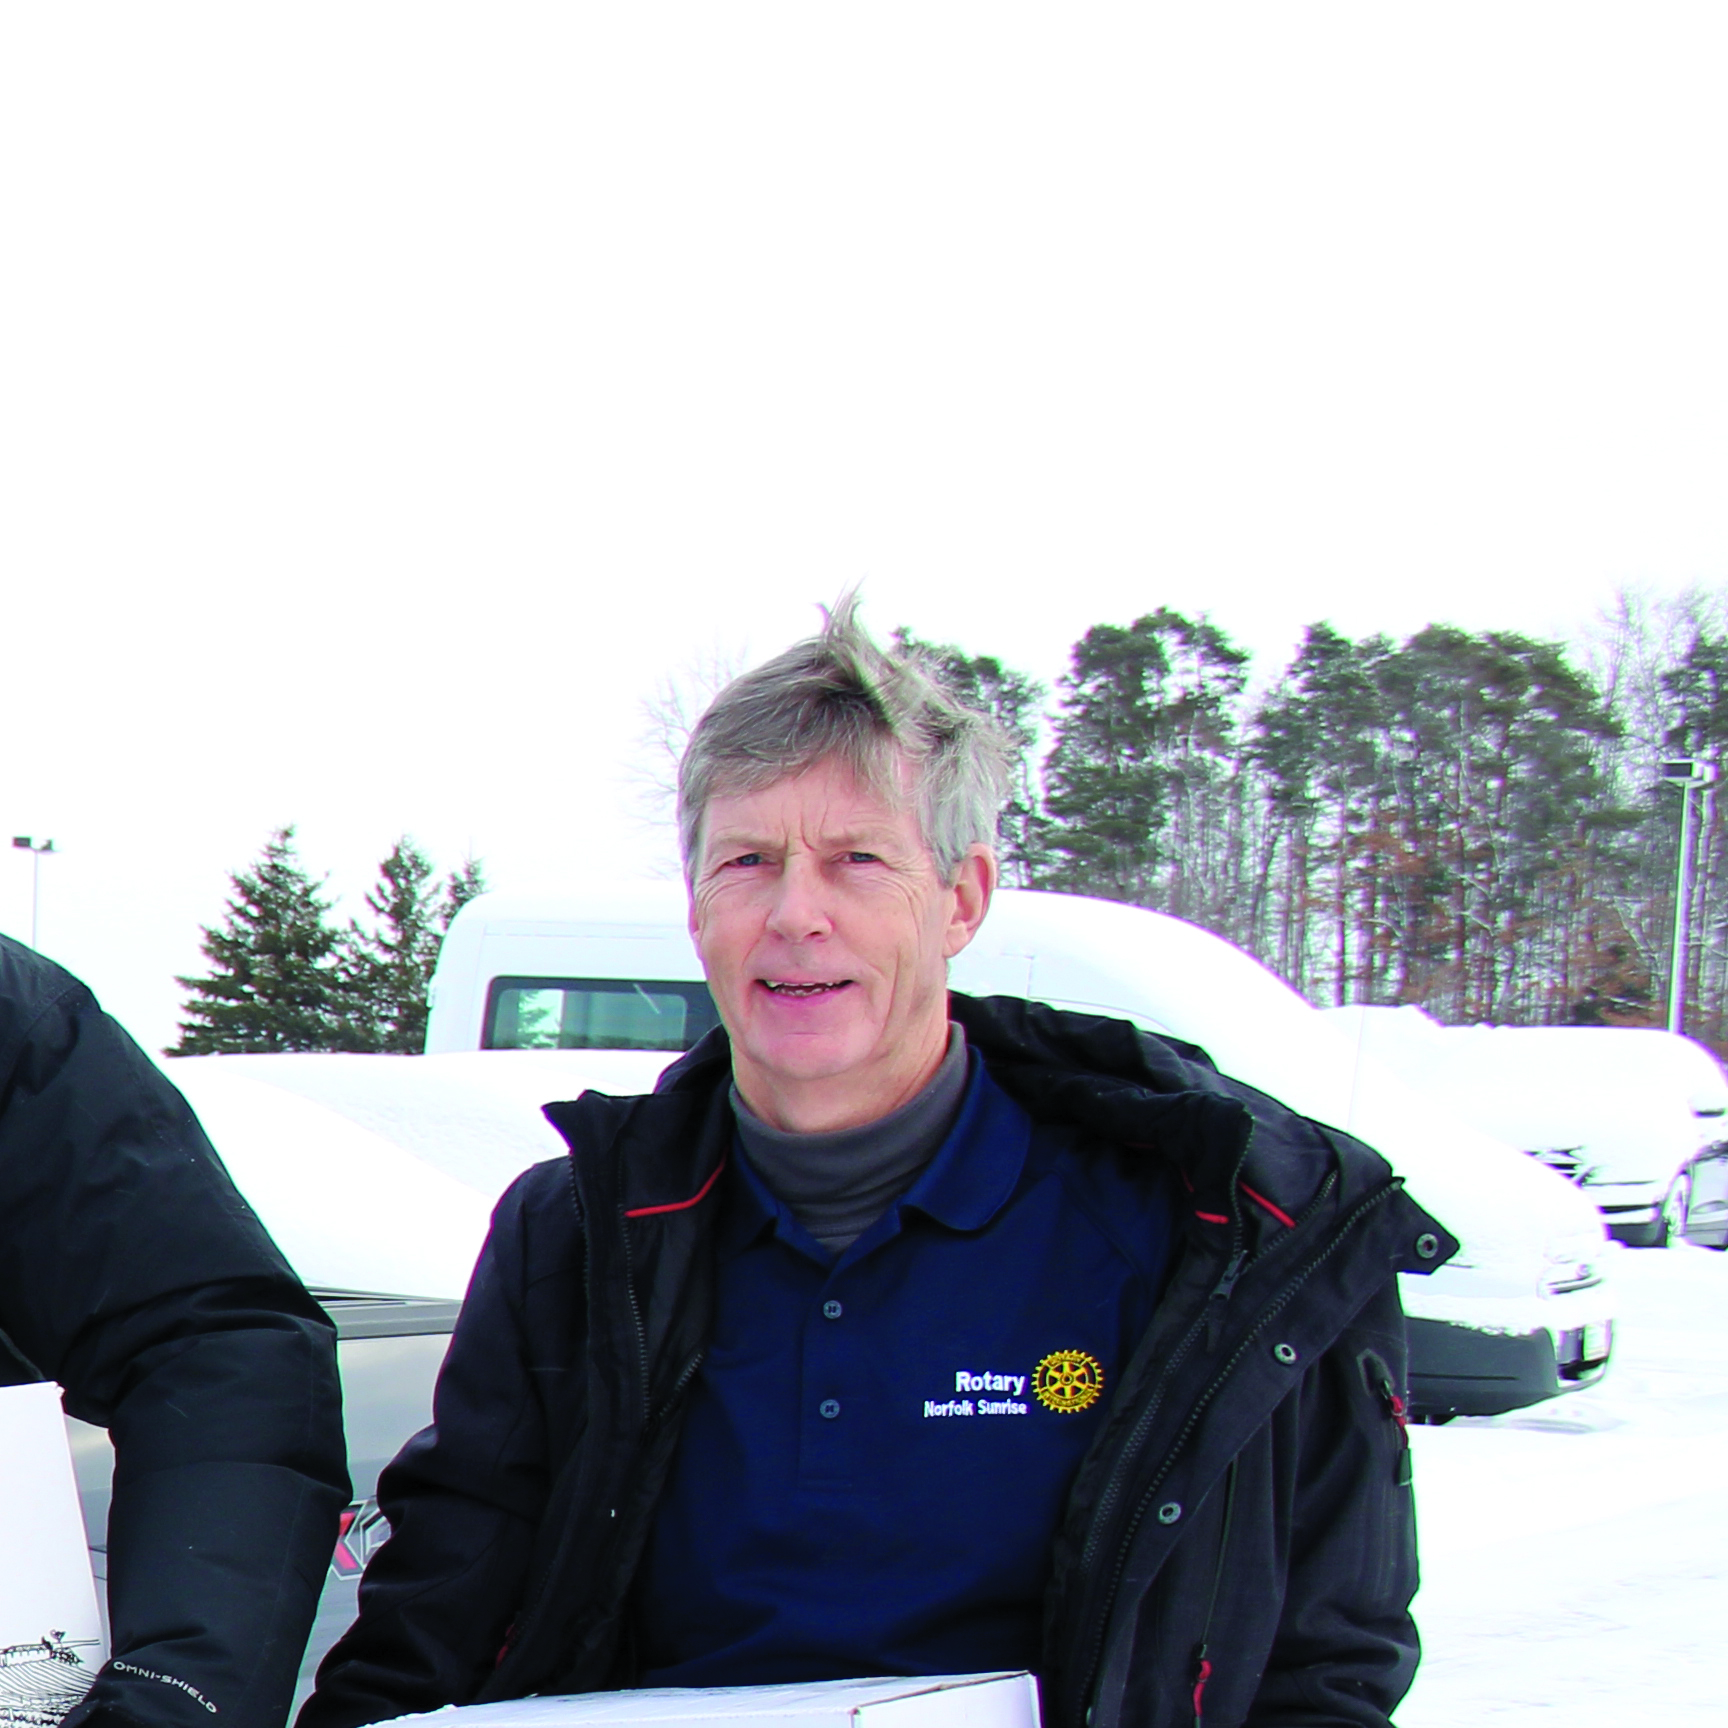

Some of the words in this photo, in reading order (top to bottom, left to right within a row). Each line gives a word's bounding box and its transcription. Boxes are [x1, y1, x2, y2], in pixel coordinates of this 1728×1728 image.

[955, 1371, 1026, 1396] Rotary
[924, 1400, 974, 1418] Norfolk
[977, 1398, 1027, 1415] Sunrise
[113, 1661, 218, 1713] OMNI-SHIELD
